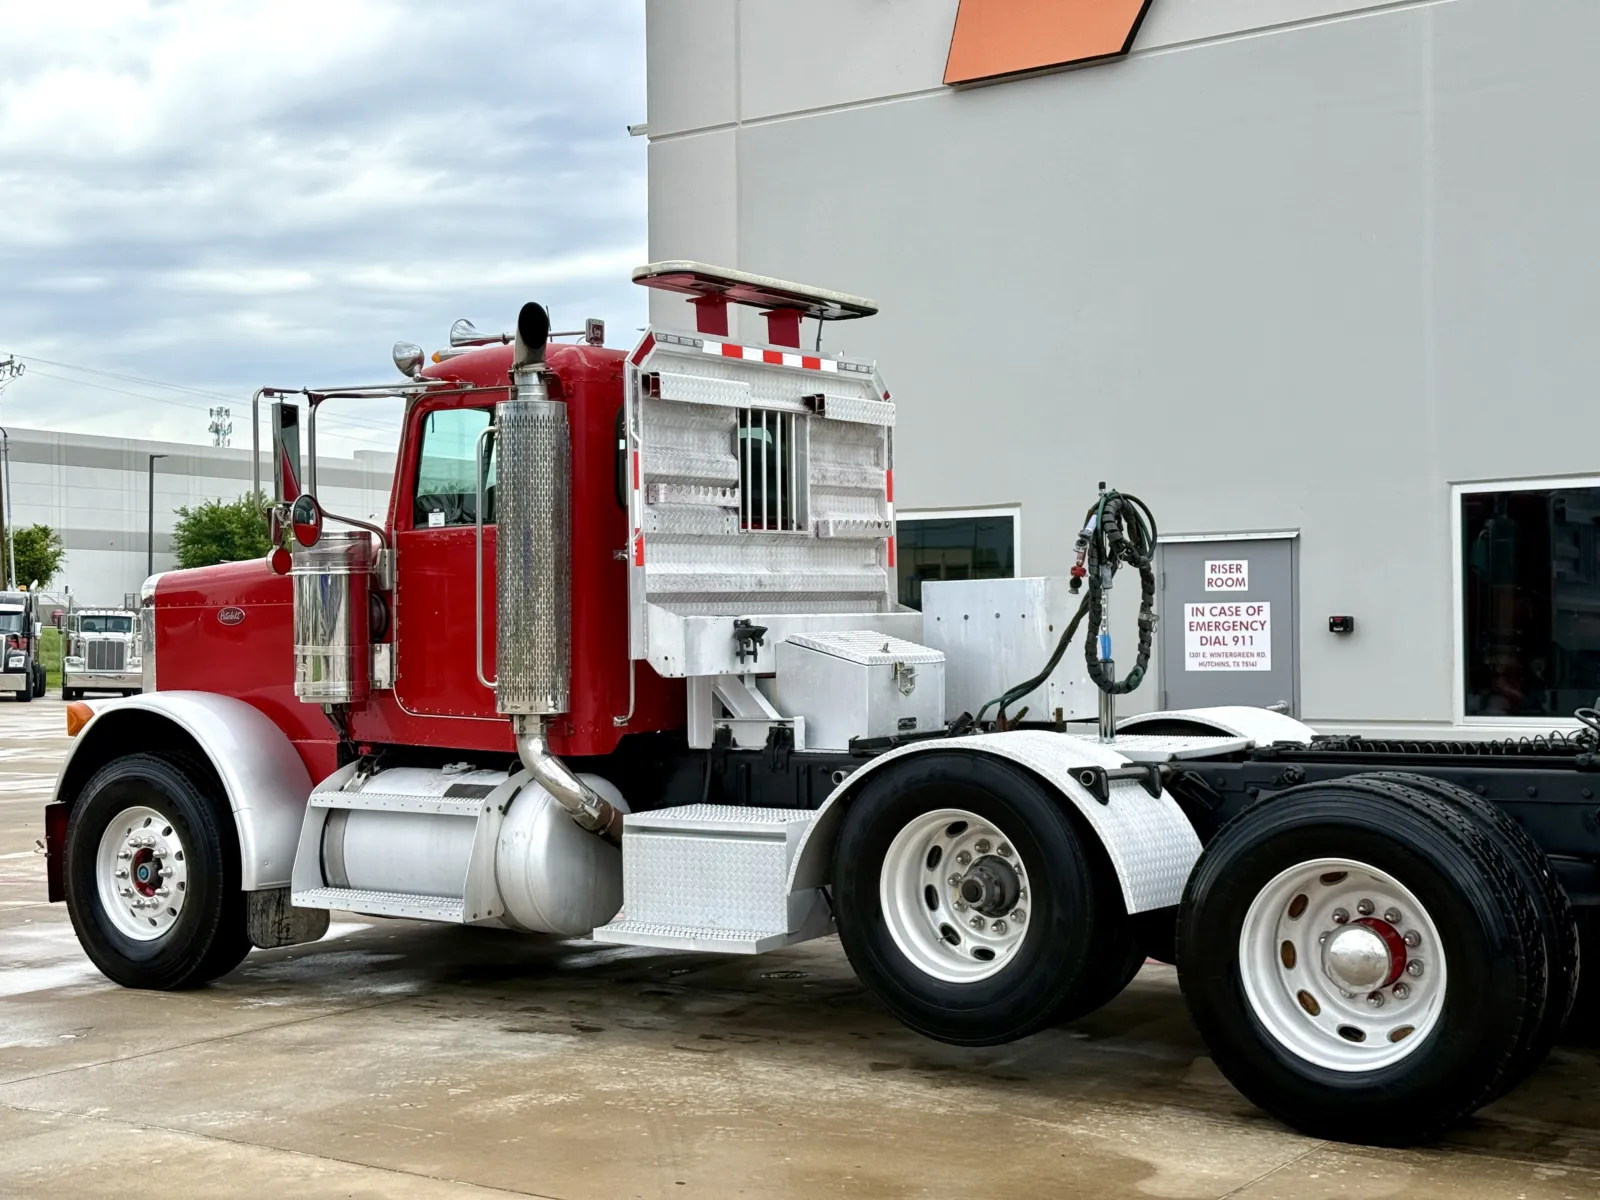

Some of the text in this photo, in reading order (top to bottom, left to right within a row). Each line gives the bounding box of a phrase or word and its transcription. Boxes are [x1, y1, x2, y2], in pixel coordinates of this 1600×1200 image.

[1210, 564, 1242, 574] RISER
[1207, 577, 1246, 588] ROOM
[1191, 605, 1264, 617] IN CASE OF
[1189, 620, 1267, 632] EMERGENCY
[1199, 635, 1254, 646] DIAL 911
